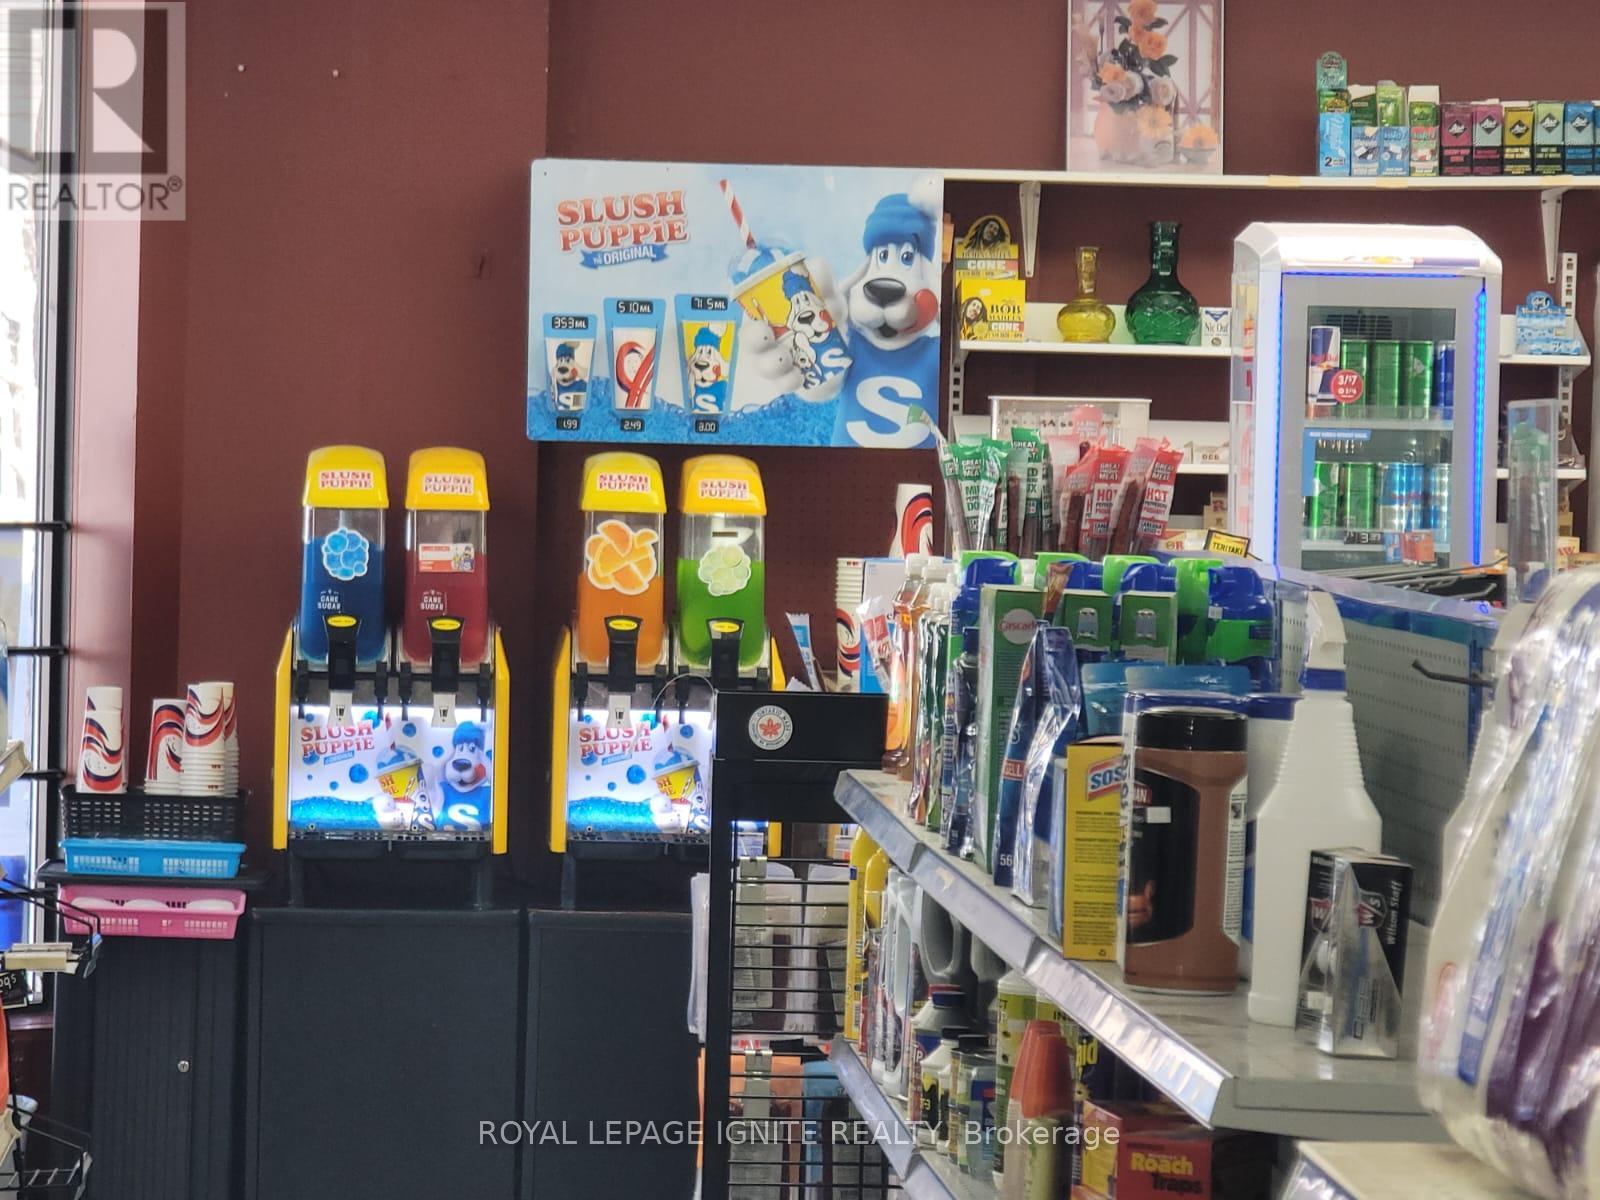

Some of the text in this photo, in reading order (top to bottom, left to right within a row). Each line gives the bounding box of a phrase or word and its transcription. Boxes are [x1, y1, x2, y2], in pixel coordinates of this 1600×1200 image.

[557, 190, 684, 225] SLUSH
[603, 246, 656, 265] ORIGINAL
[967, 260, 1006, 270] CONE
[990, 304, 1021, 314] BOB
[554, 317, 587, 329] 353ML
[991, 322, 1020, 331] CONE
[846, 375, 932, 449] S
[320, 470, 372, 480] SLUSH
[424, 475, 473, 485] SLUSH
[600, 474, 649, 484] SLUSH
[1100, 472, 1119, 481] MEAT
[320, 479, 373, 489] PUPPIE
[701, 480, 748, 490] SLUSH
[1146, 488, 1169, 502] HOT
[320, 595, 339, 603] CANE
[423, 596, 442, 604] CANE
[317, 602, 342, 610] SUGAR
[420, 603, 444, 611] SUGAR
[998, 619, 1037, 632] Cascad
[301, 720, 373, 742] SLUSH
[578, 722, 651, 743] SLUSH
[1090, 766, 1123, 790] SOS
[1386, 880, 1403, 945] Wilson Staff
[1076, 1038, 1098, 1067] aid
[1130, 1151, 1194, 1176] Roach
[1151, 1173, 1203, 1195] Traps
